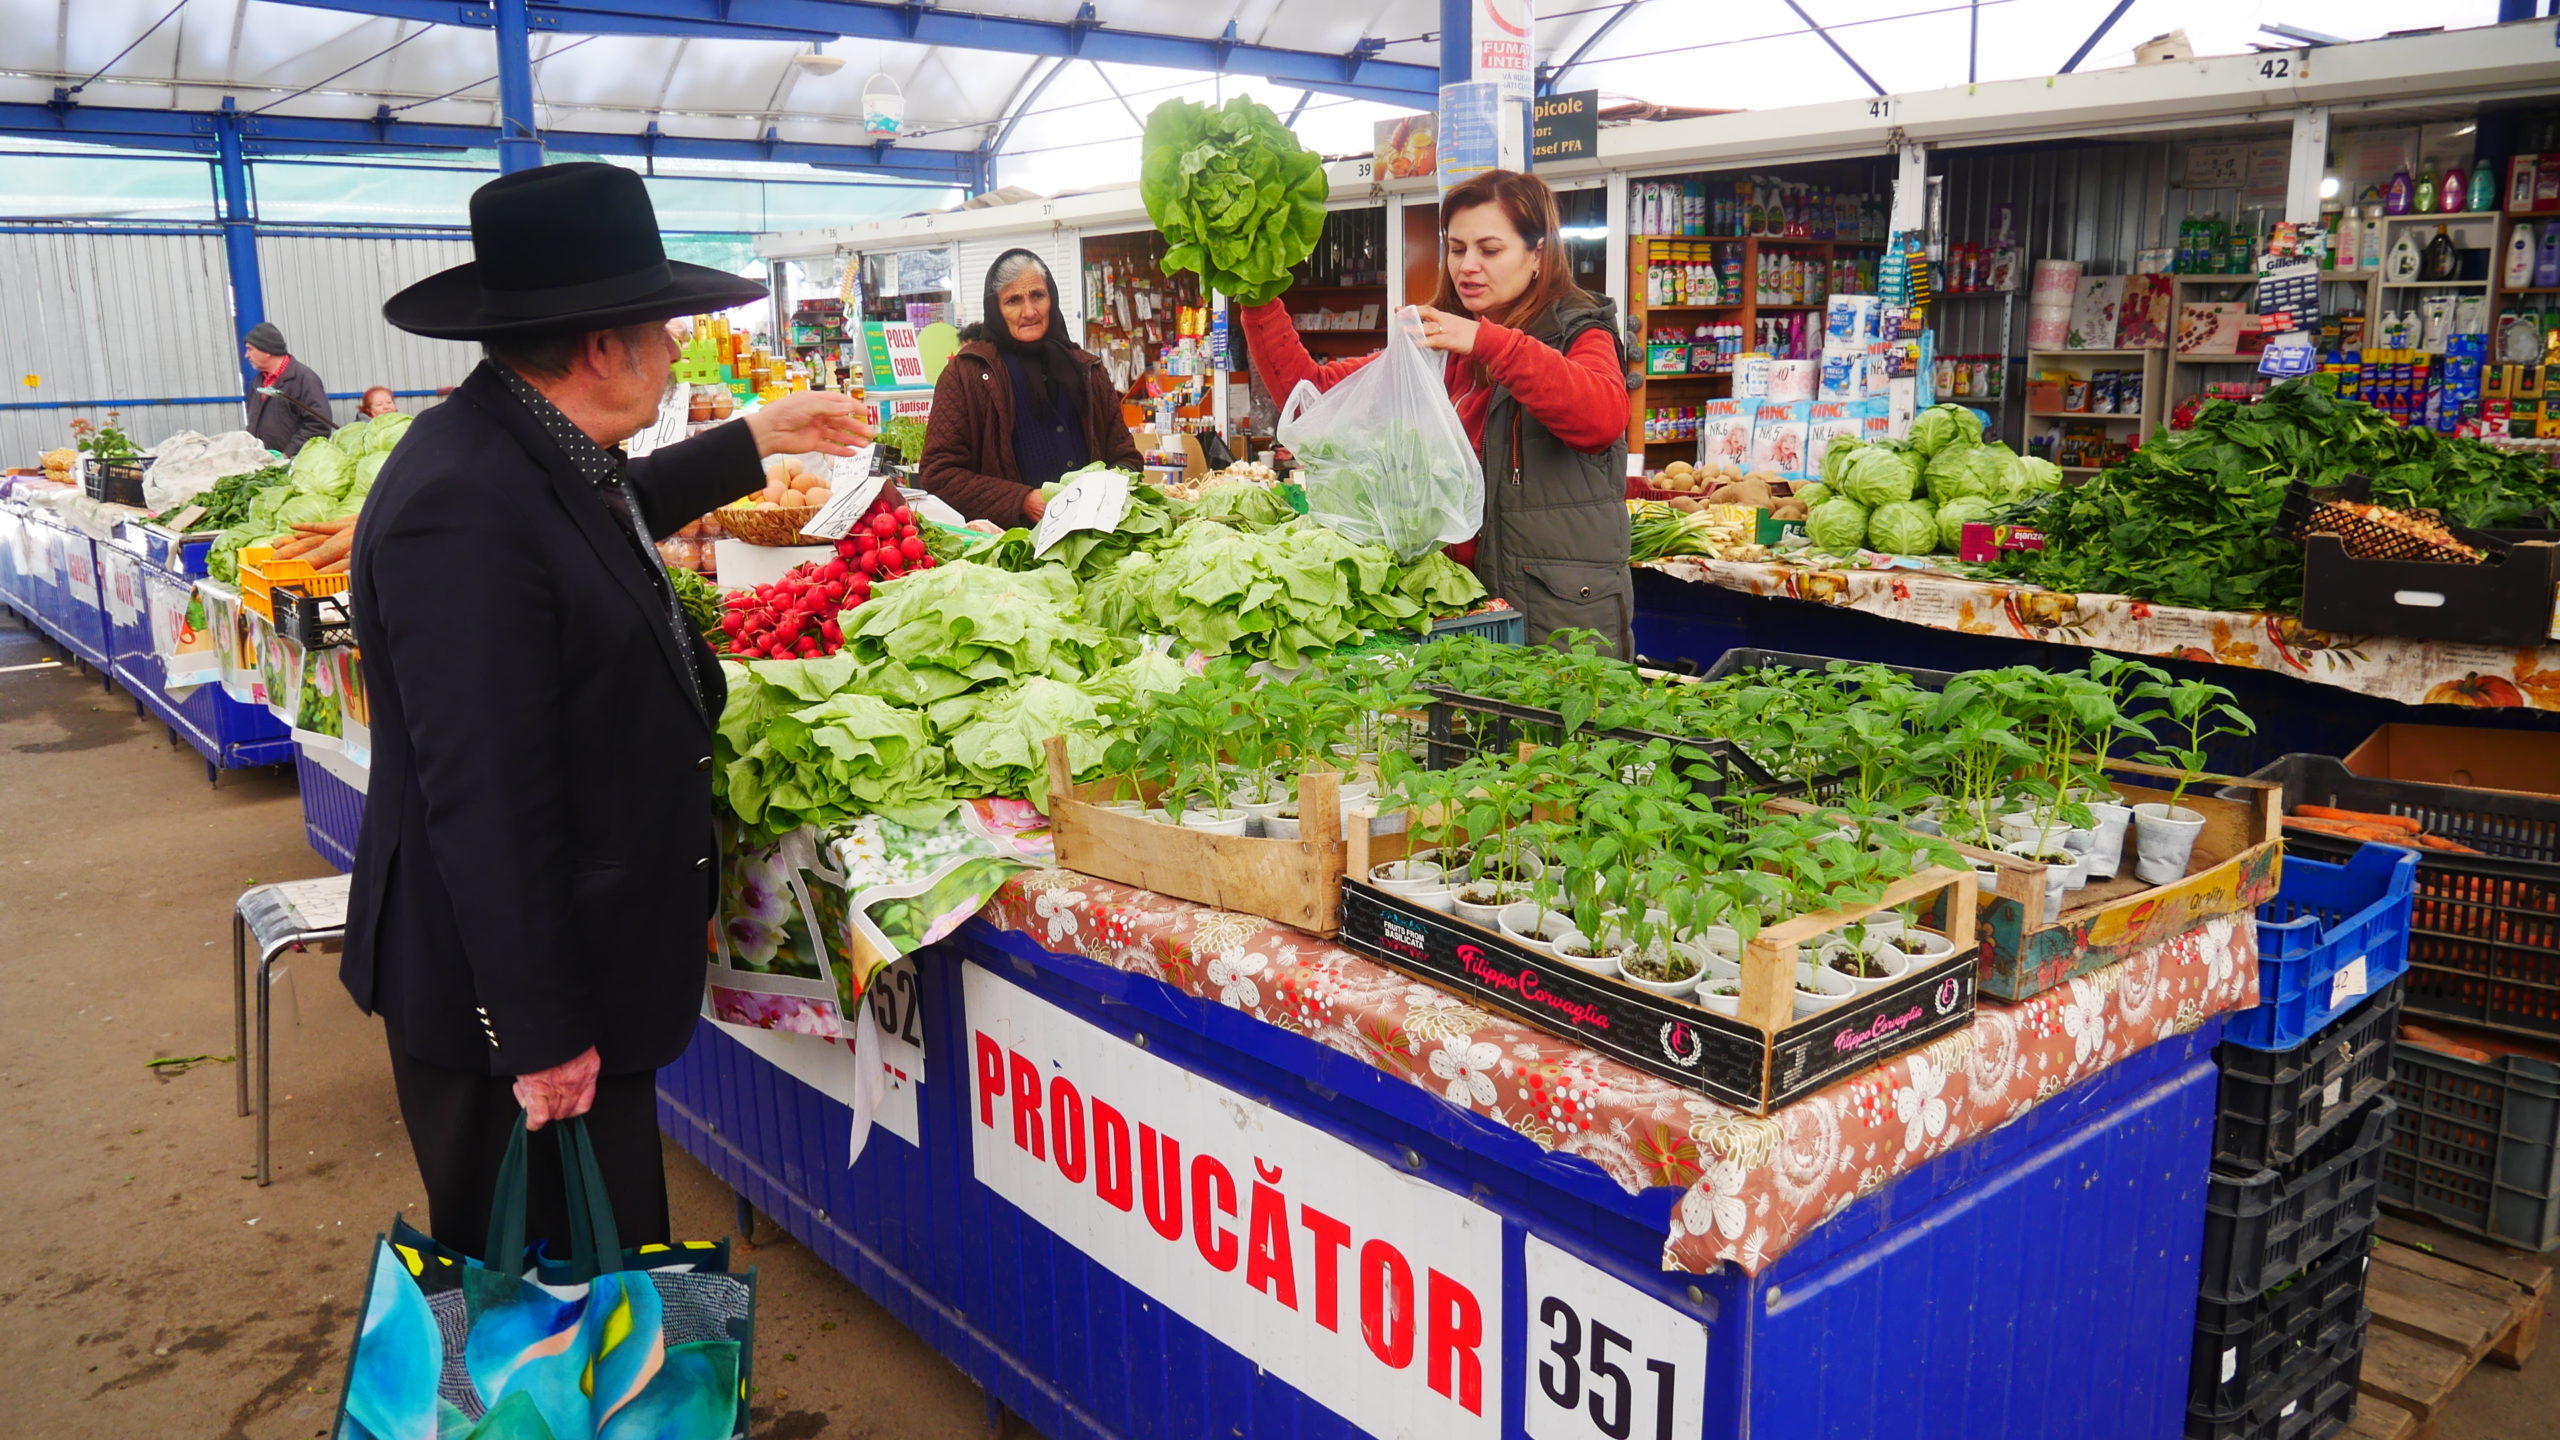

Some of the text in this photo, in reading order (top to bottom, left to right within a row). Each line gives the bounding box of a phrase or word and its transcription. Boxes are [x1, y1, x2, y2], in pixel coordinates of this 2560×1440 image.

[2259, 58, 2289, 78] 42
[1869, 101, 1889, 117] 41
[1561, 139, 1583, 153] PFA
[1358, 163, 1371, 177] 39
[2267, 256, 2308, 270] Gillette
[886, 328, 916, 348] POLEN
[894, 357, 921, 377] CRUD
[2014, 531, 2044, 542] ezuela
[2189, 886, 2226, 911] Quality
[1383, 920, 1425, 943] FRUITS FROM
[1384, 929, 1424, 951] BASILICATA
[1456, 944, 1610, 1030] Filippo Corvaglia
[868, 966, 921, 1049] 52
[1833, 1028, 1871, 1053] Filippo
[1871, 1005, 1924, 1038] Corvaglia
[975, 1029, 1483, 1418] PRODUCĂTOR
[1539, 1296, 1676, 1440] 351
